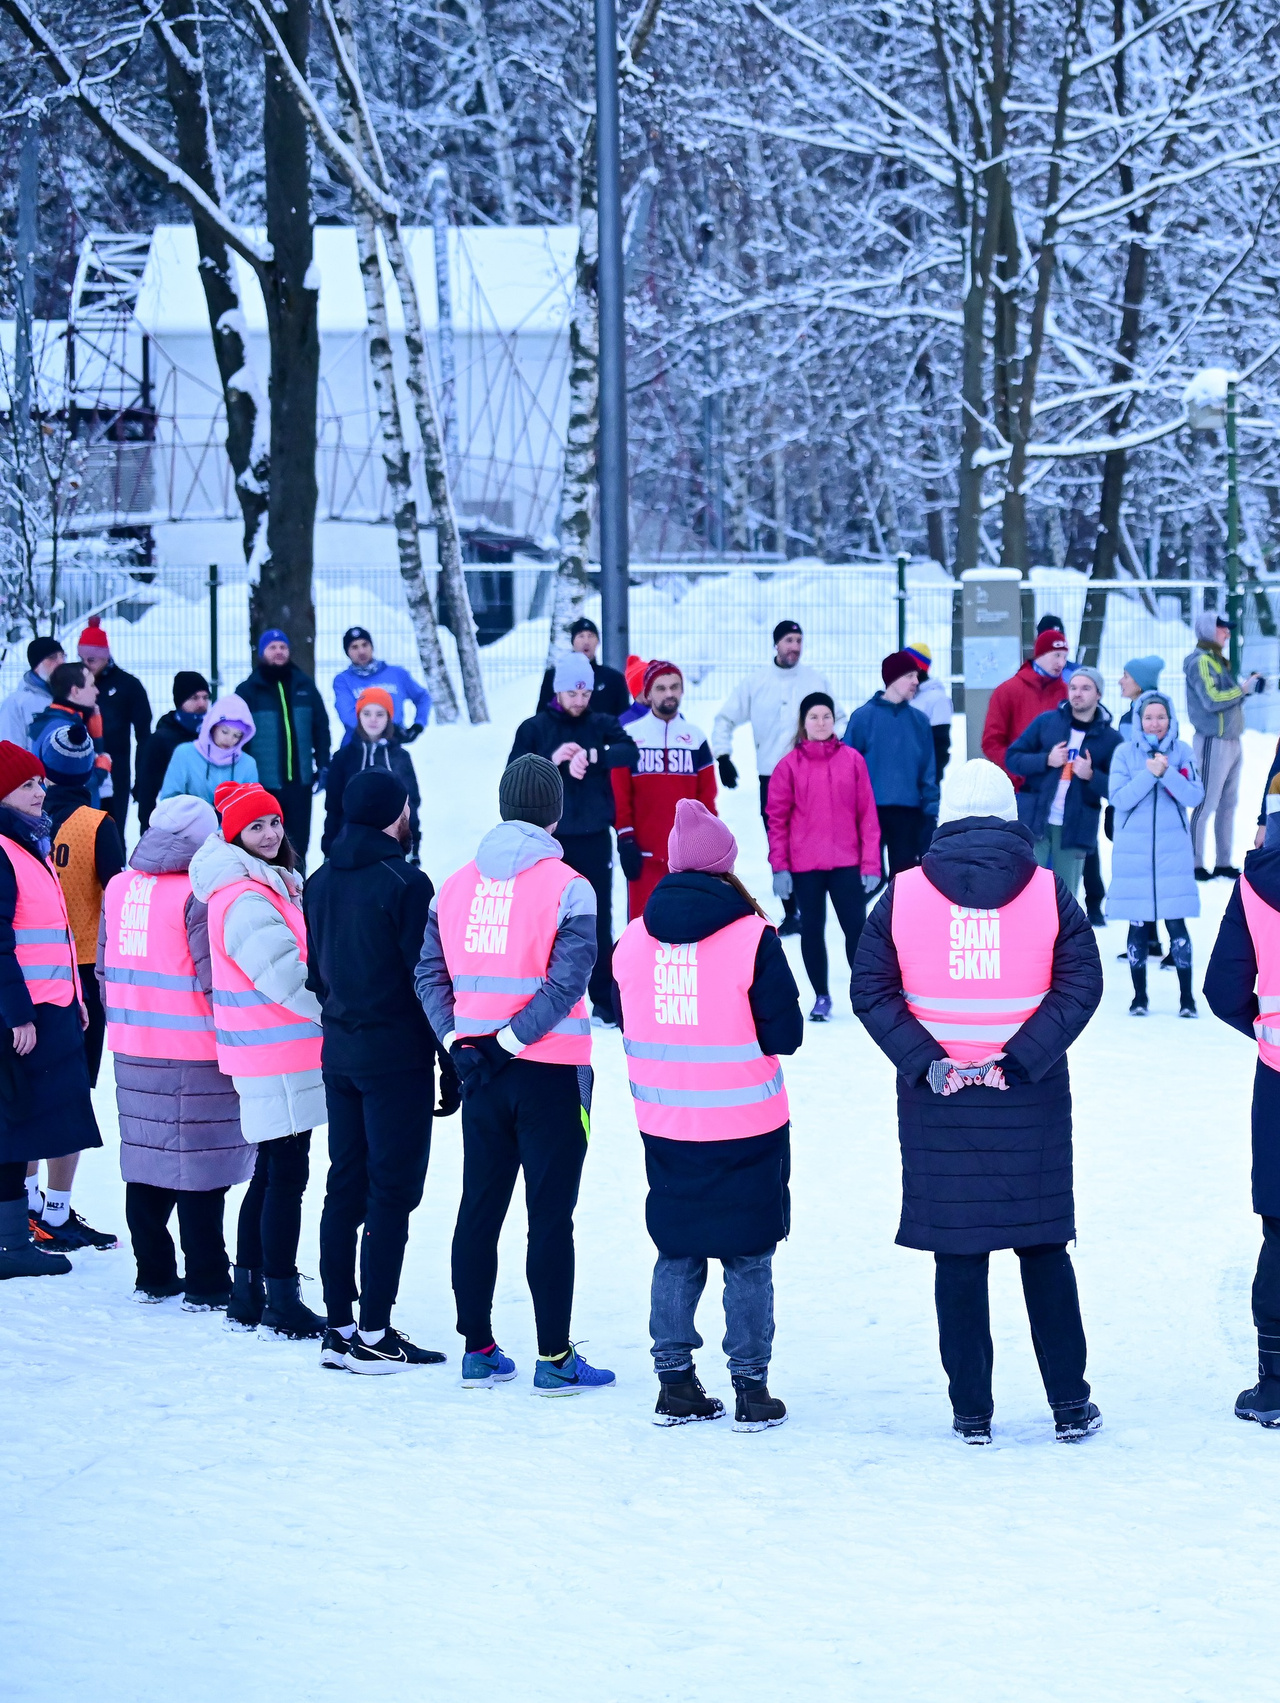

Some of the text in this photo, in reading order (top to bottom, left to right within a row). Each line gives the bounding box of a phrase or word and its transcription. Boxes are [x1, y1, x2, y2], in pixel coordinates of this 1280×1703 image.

[125, 874, 157, 905] Sat
[120, 903, 150, 931] 9AM
[468, 896, 513, 925] 9AM
[118, 929, 148, 957] 5KM
[464, 924, 508, 955] 5KM
[950, 919, 1000, 950] 9AM
[654, 964, 698, 995] 9AM
[949, 949, 1001, 980] 5KM
[654, 994, 699, 1026] 5KM
